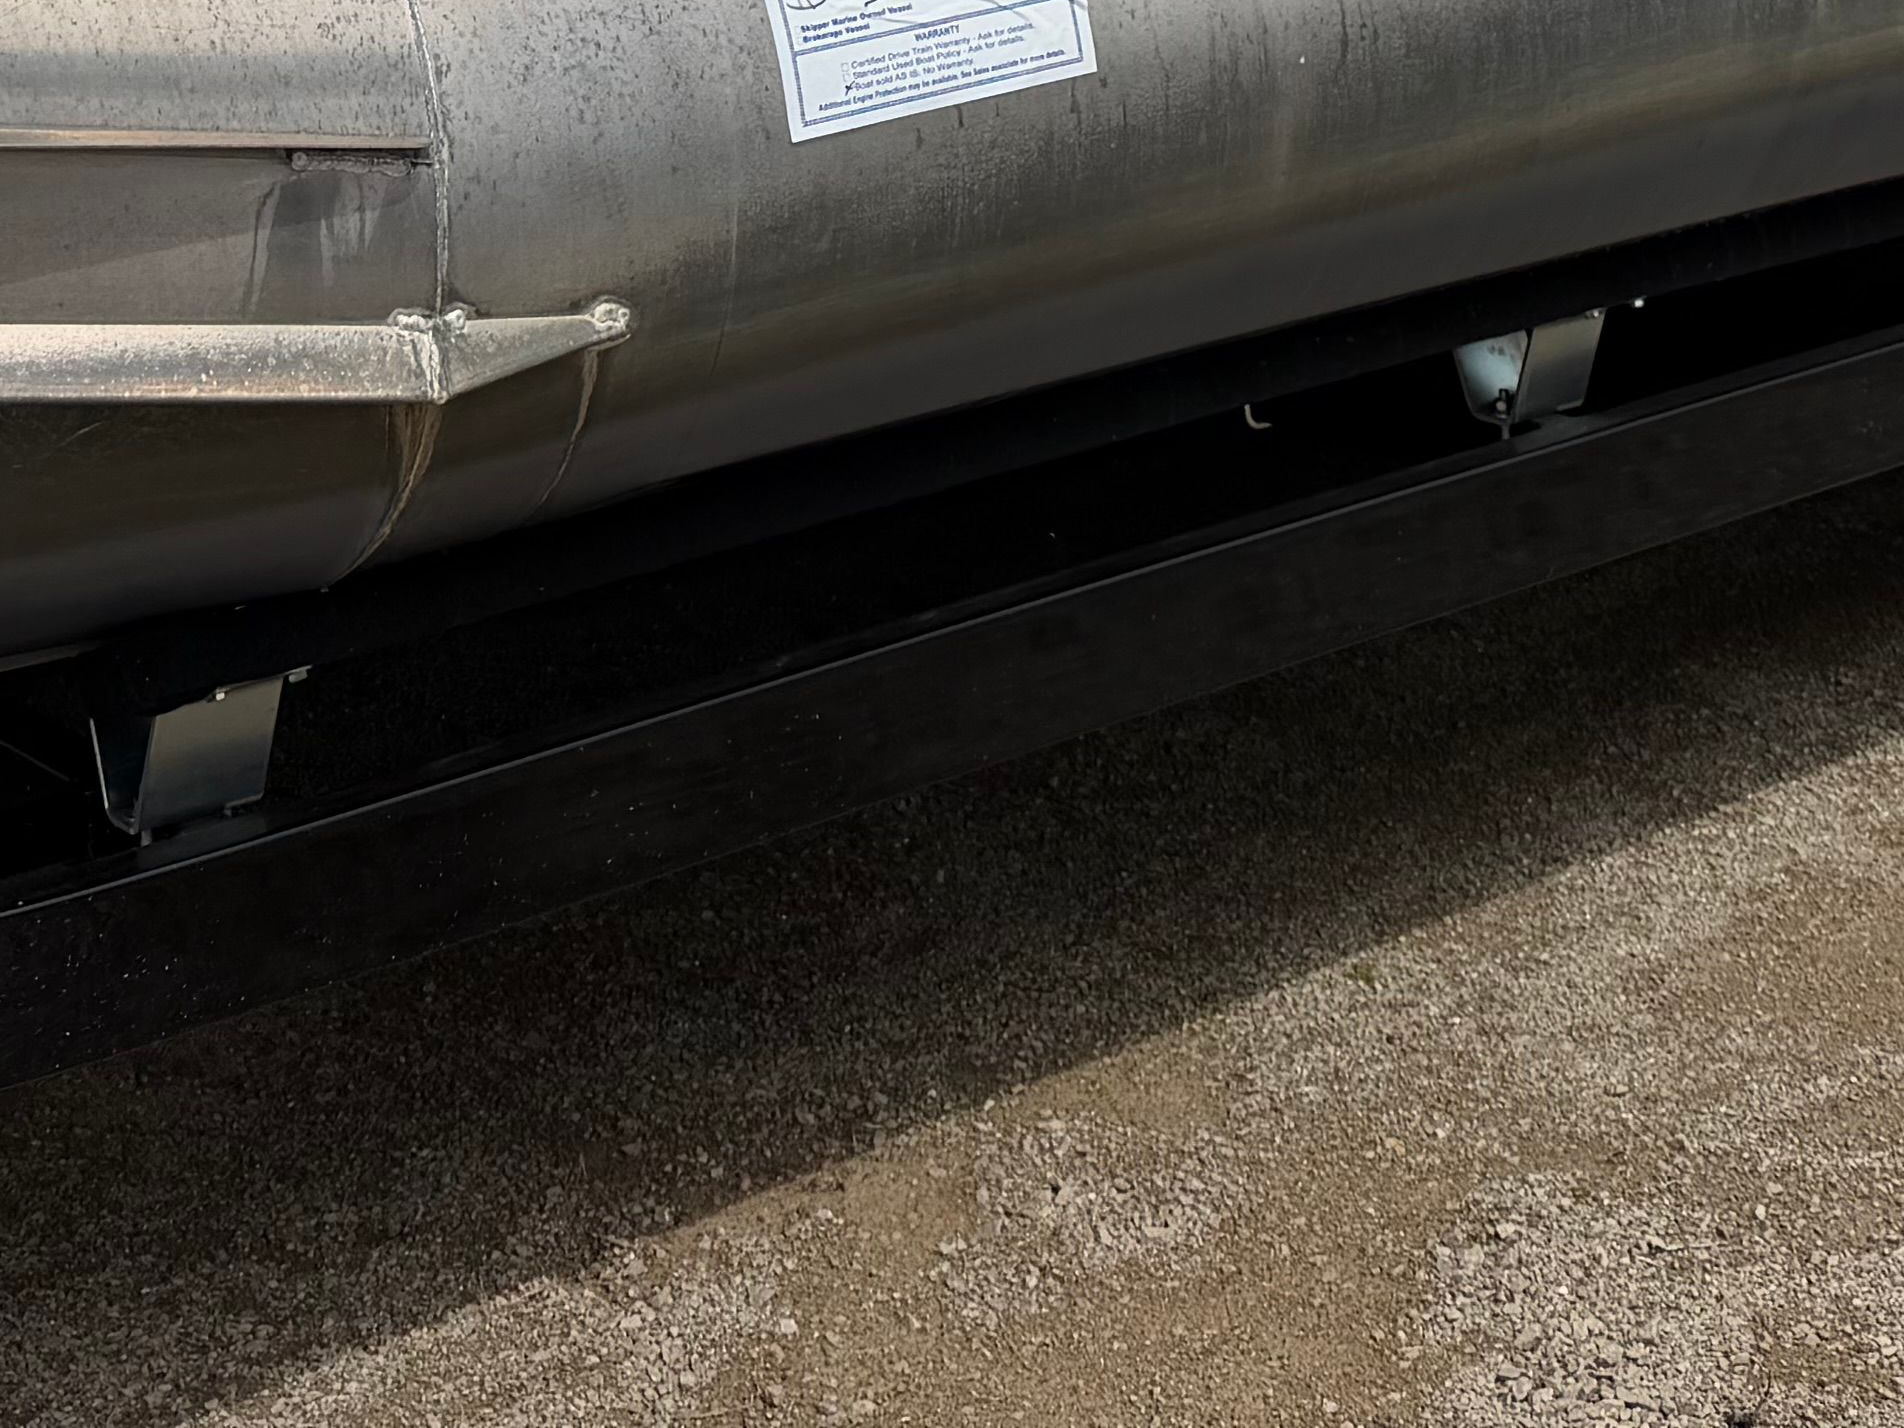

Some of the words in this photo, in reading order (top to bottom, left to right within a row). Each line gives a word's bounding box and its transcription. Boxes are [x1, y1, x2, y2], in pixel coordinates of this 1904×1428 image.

[800, 21, 830, 33] Skipper
[831, 16, 858, 25] Marine
[859, 8, 886, 20] Owned
[887, 3, 912, 14] Vessel
[803, 30, 843, 43] Brokerage
[845, 23, 870, 34] Vessel
[914, 24, 960, 41] WARRANTY
[851, 55, 886, 69] Certified
[887, 51, 910, 61] Drive
[911, 45, 933, 55] Train
[934, 37, 971, 50] Warranty
[977, 31, 993, 41] Ask
[994, 28, 1005, 37] for
[853, 65, 890, 79] Standard
[892, 60, 914, 70] Used
[915, 55, 935, 66] Boat
[936, 48, 961, 60] Policy
[968, 44, 984, 54] Ask
[985, 41, 995, 50] for
[819, 97, 852, 112] Additional
[853, 93, 874, 104] Engine
[875, 85, 907, 97] Protection
[909, 83, 921, 92] may
[922, 79, 930, 87] be
[961, 70, 972, 79] See
[973, 67, 989, 76] Sales
[991, 59, 1019, 71] associate
[1020, 56, 1028, 64] for
[1030, 54, 1044, 62] more
[855, 80, 874, 91] Boat
[875, 75, 894, 86] sold
[895, 71, 907, 81] AS
[923, 64, 935, 74] No
